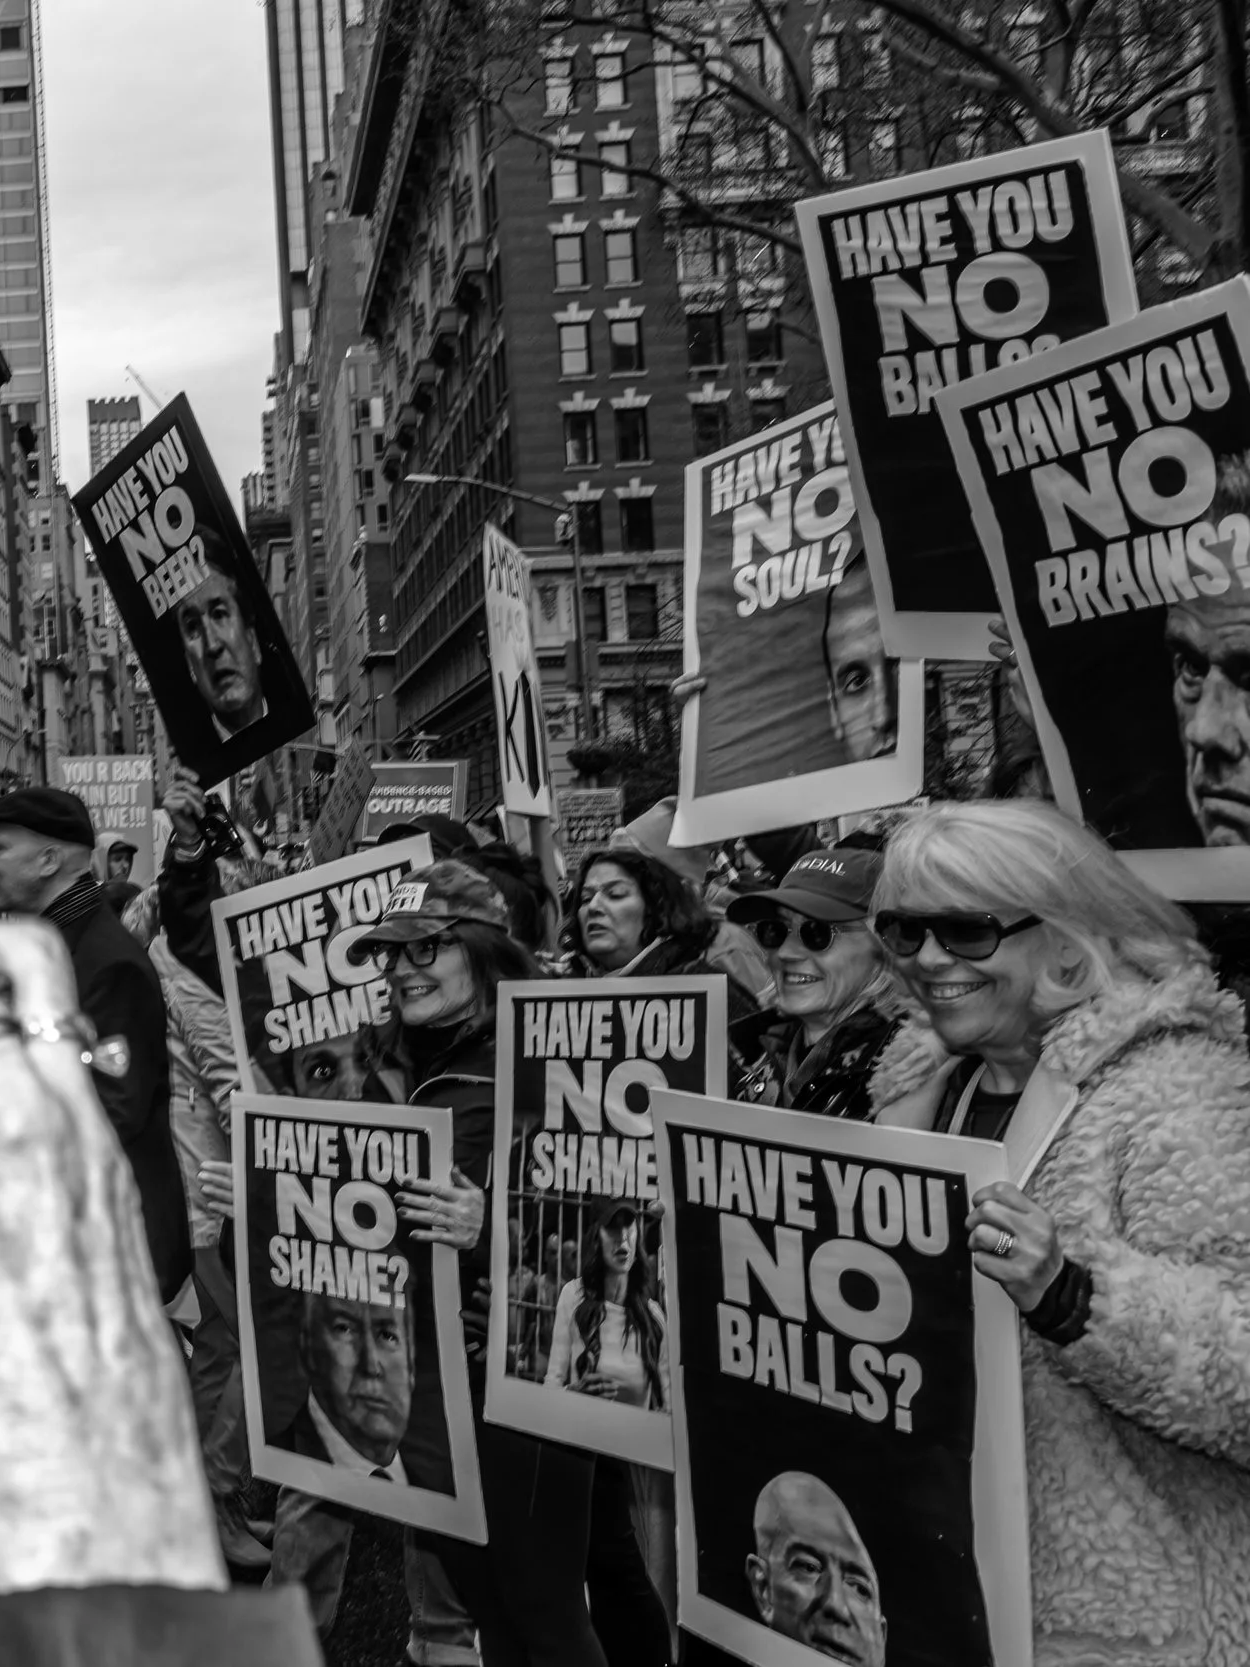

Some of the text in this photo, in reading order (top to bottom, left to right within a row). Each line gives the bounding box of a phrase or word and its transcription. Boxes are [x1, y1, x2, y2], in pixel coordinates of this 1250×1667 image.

[831, 170, 1074, 281] HAVE YOU
[870, 251, 1050, 354] NO
[978, 328, 1230, 477] HAVE YOU
[91, 424, 189, 544] HAVE YOU
[711, 430, 803, 517] HAVE
[1031, 425, 1217, 553] NO
[119, 485, 195, 583] NO
[732, 465, 856, 570] NO
[141, 535, 210, 620] BEER?
[733, 530, 852, 618] SOUL?
[1035, 513, 1250, 628] BRAINS?
[62, 761, 94, 784] YOU
[97, 761, 108, 783] R
[106, 783, 140, 806] BUT
[367, 798, 452, 814] OUTRAGE
[236, 892, 329, 961] HAVE
[265, 924, 391, 1008] NO
[523, 998, 695, 1062] HAVE YOU
[544, 1058, 669, 1138] NO
[254, 1117, 419, 1187] HAVE YOU
[682, 1132, 949, 1256] HAVE YOU
[275, 1171, 398, 1250] NO
[268, 1235, 410, 1310] SHAME?
[719, 1211, 913, 1343] NO
[716, 1302, 922, 1434] BALLS?
